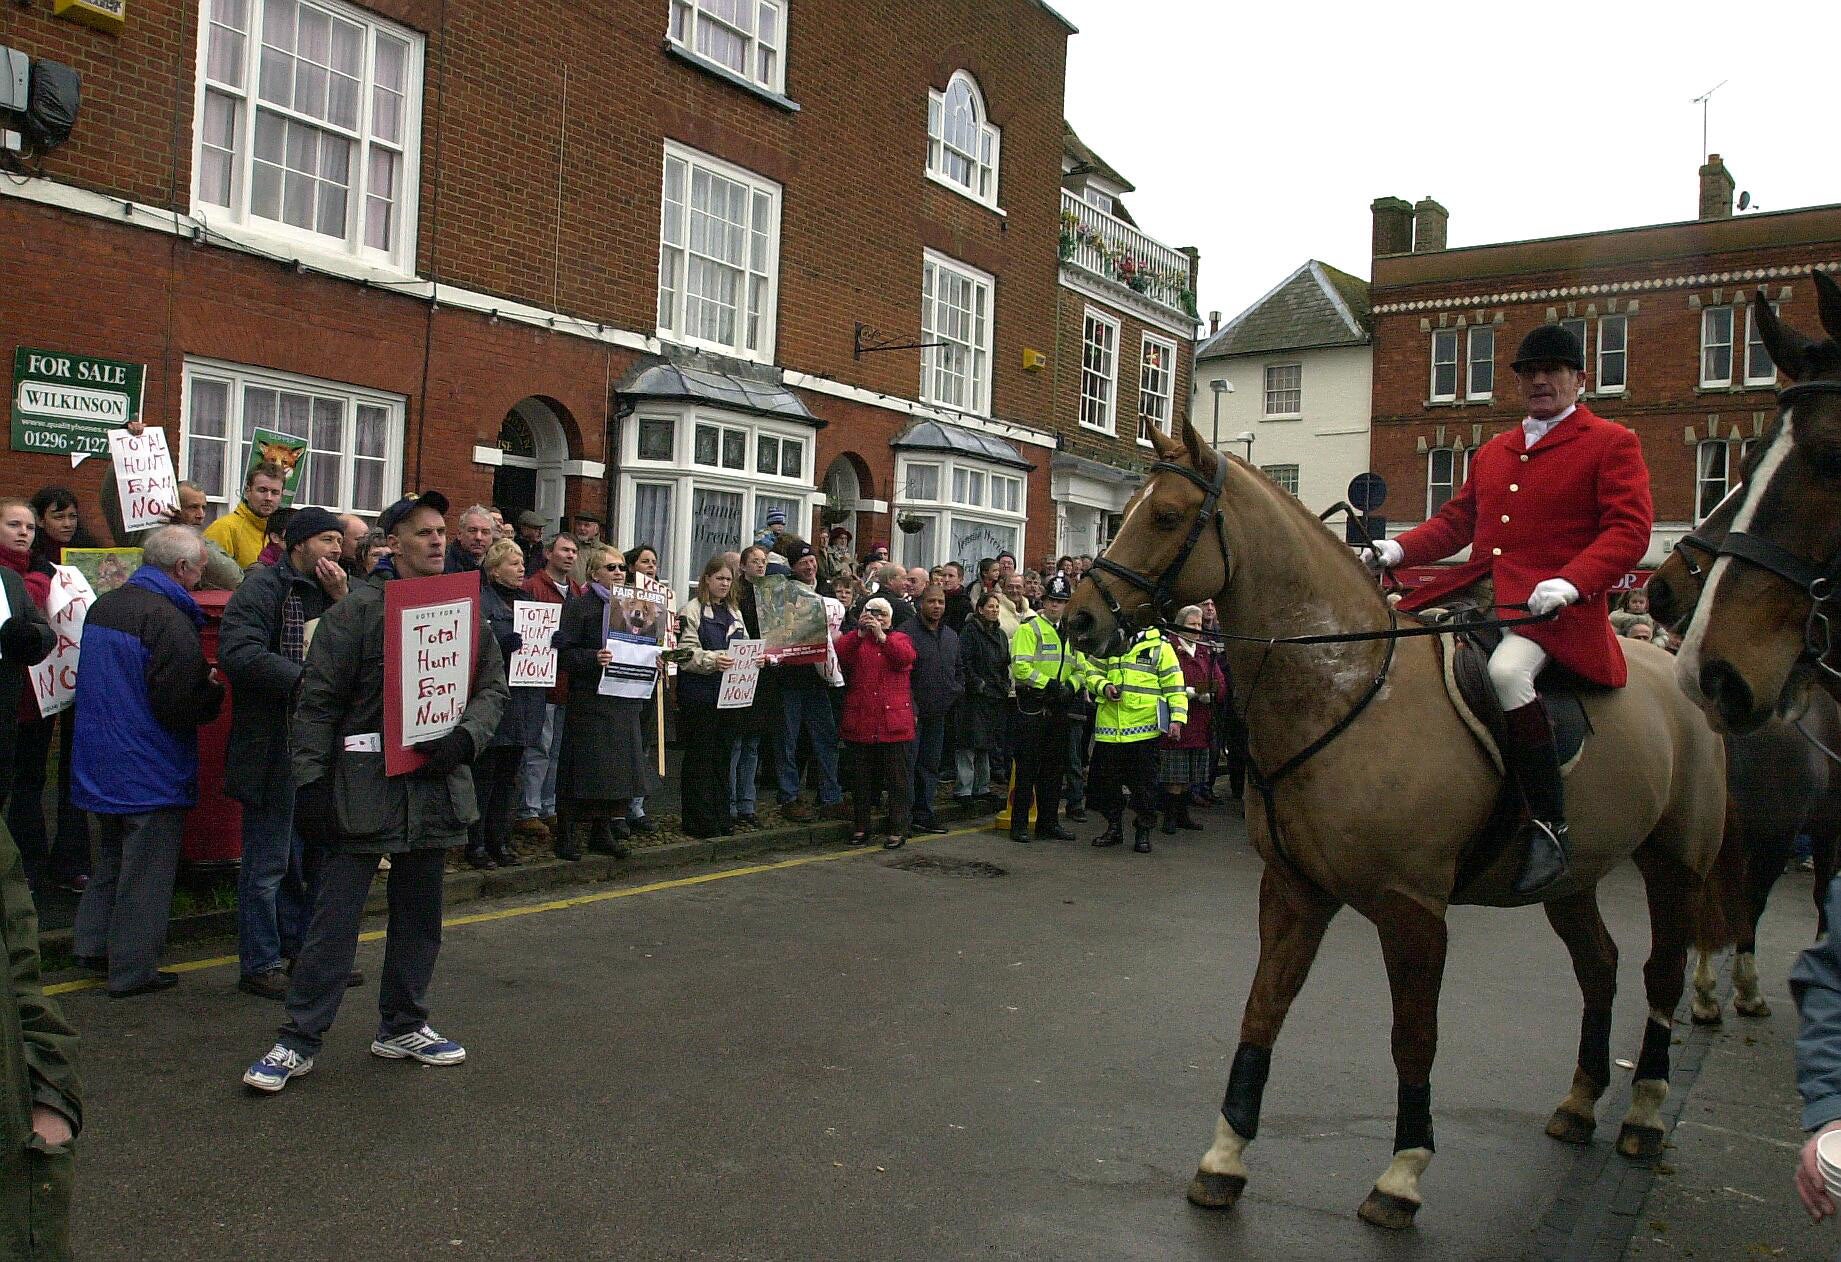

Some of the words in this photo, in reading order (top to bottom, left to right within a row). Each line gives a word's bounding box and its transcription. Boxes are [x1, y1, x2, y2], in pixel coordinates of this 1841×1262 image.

[28, 354, 71, 378] FOR
[77, 361, 127, 385] SALE
[25, 389, 124, 416] WILKINSON
[24, 430, 67, 449] 01296
[116, 433, 165, 452] TOTAL
[123, 454, 165, 474] HUNT
[127, 475, 171, 494] BAN
[612, 586, 635, 599] FAIR
[519, 607, 557, 624] TOTAL
[413, 620, 459, 645] Total
[521, 624, 555, 640] HUNT
[733, 643, 761, 656] TOTAL
[417, 650, 460, 673] Hunt
[515, 653, 554, 679] NOW!
[417, 677, 457, 700] Ban
